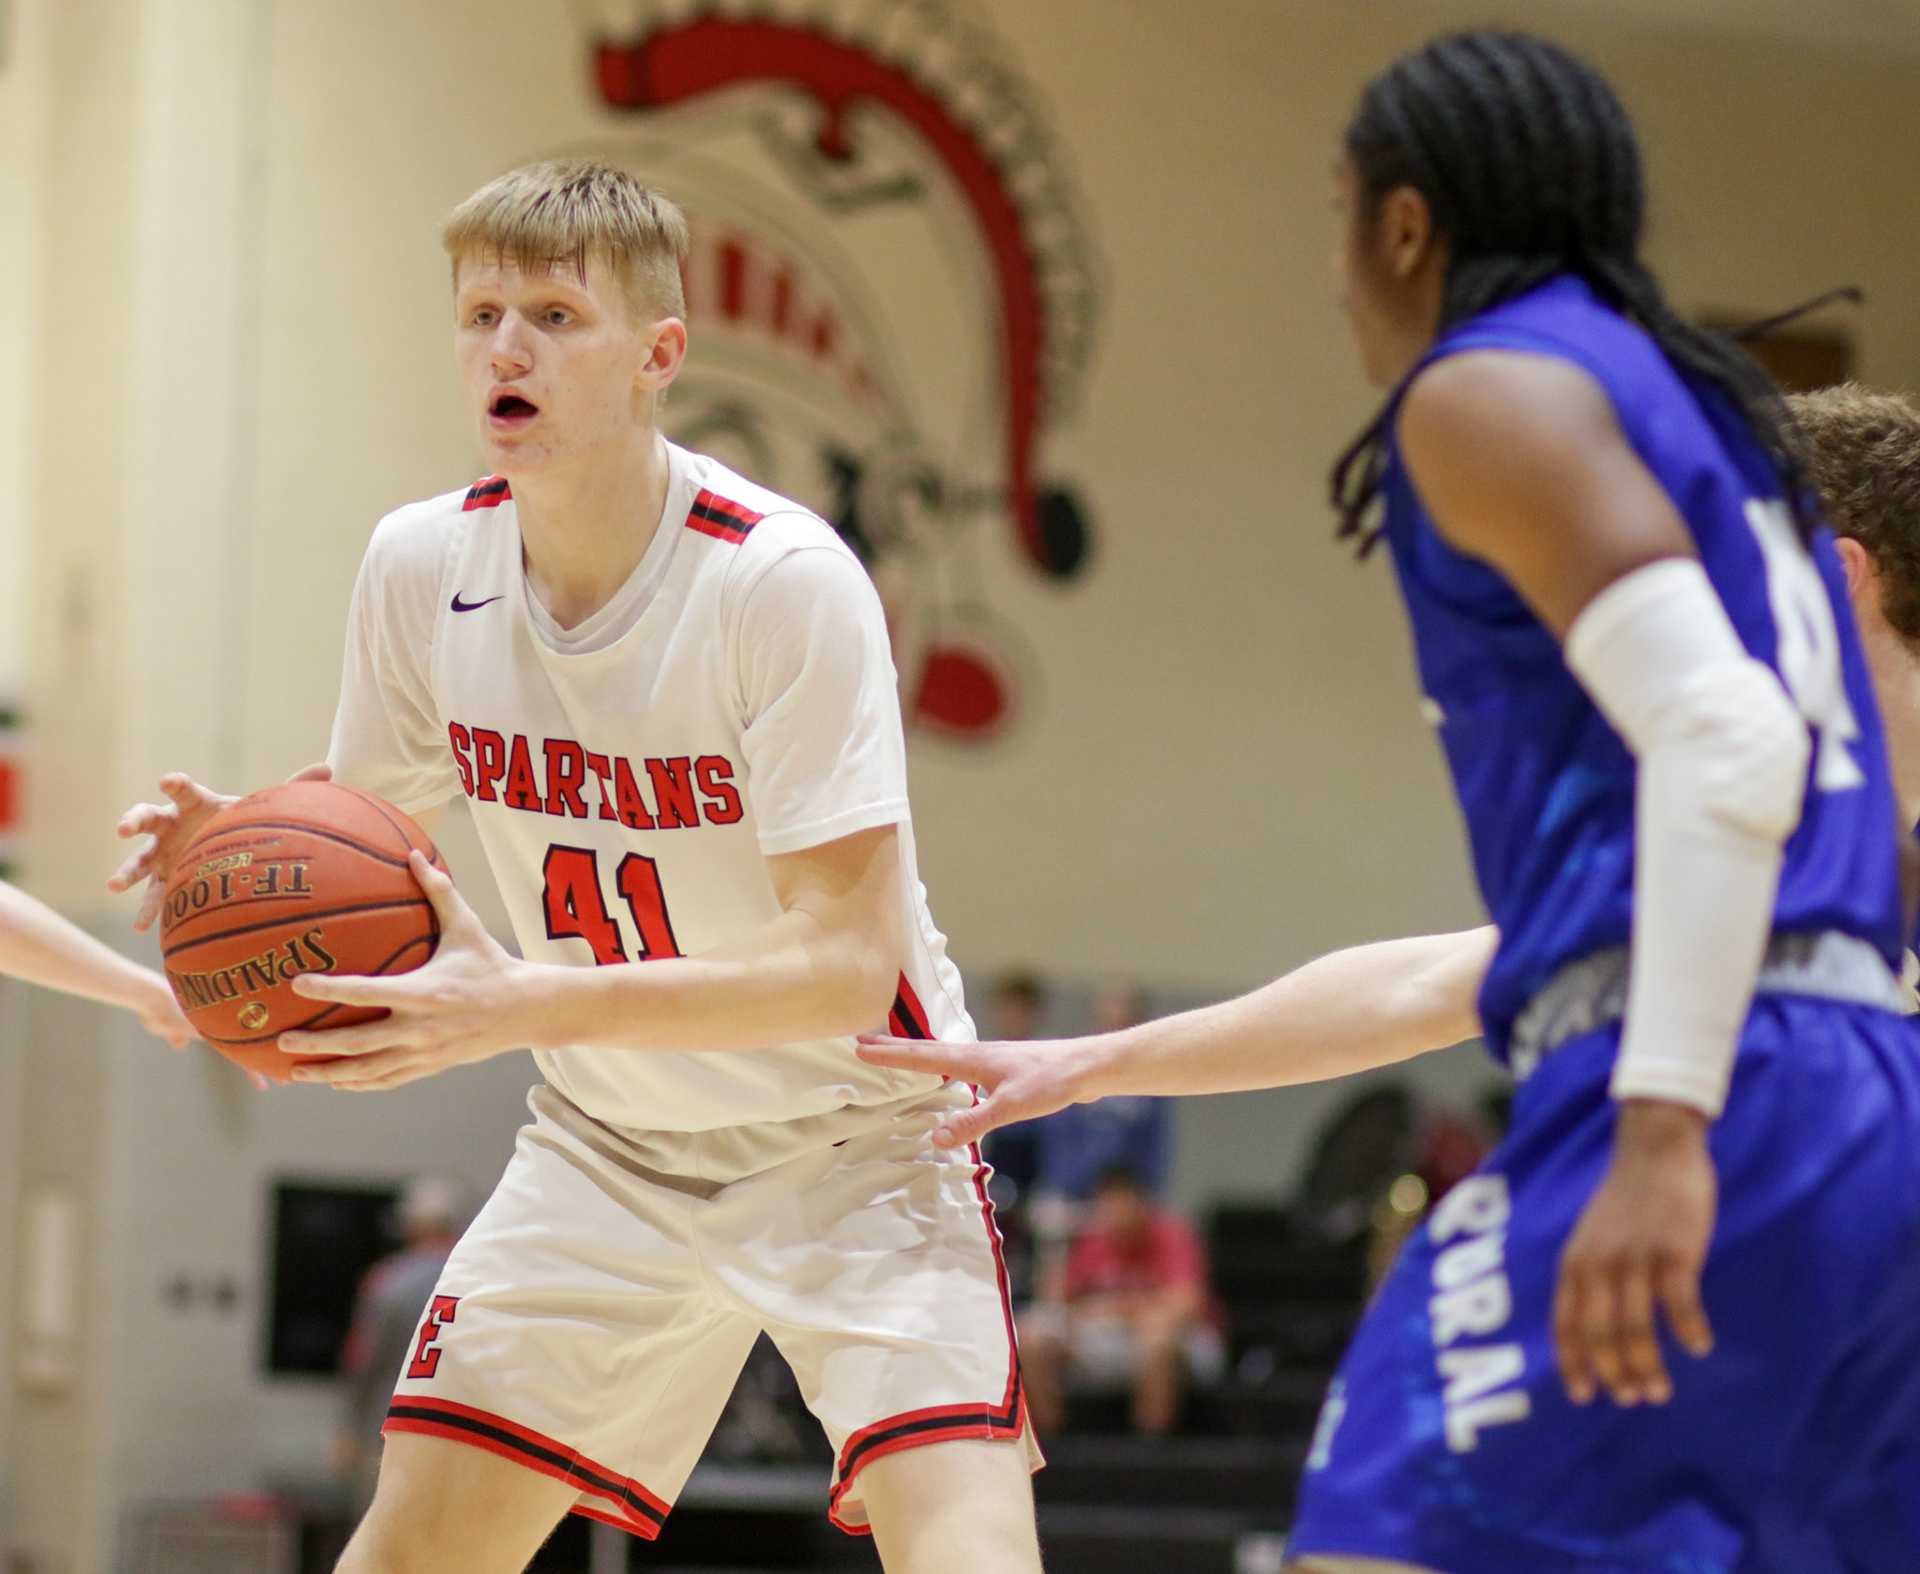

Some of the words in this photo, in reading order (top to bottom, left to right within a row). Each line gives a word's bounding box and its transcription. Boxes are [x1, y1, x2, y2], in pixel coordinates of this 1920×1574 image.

[448, 720, 744, 830] SPARTANS
[541, 843, 688, 967] 41
[169, 925, 337, 1012] SPALDIN
[406, 1294, 462, 1379] E
